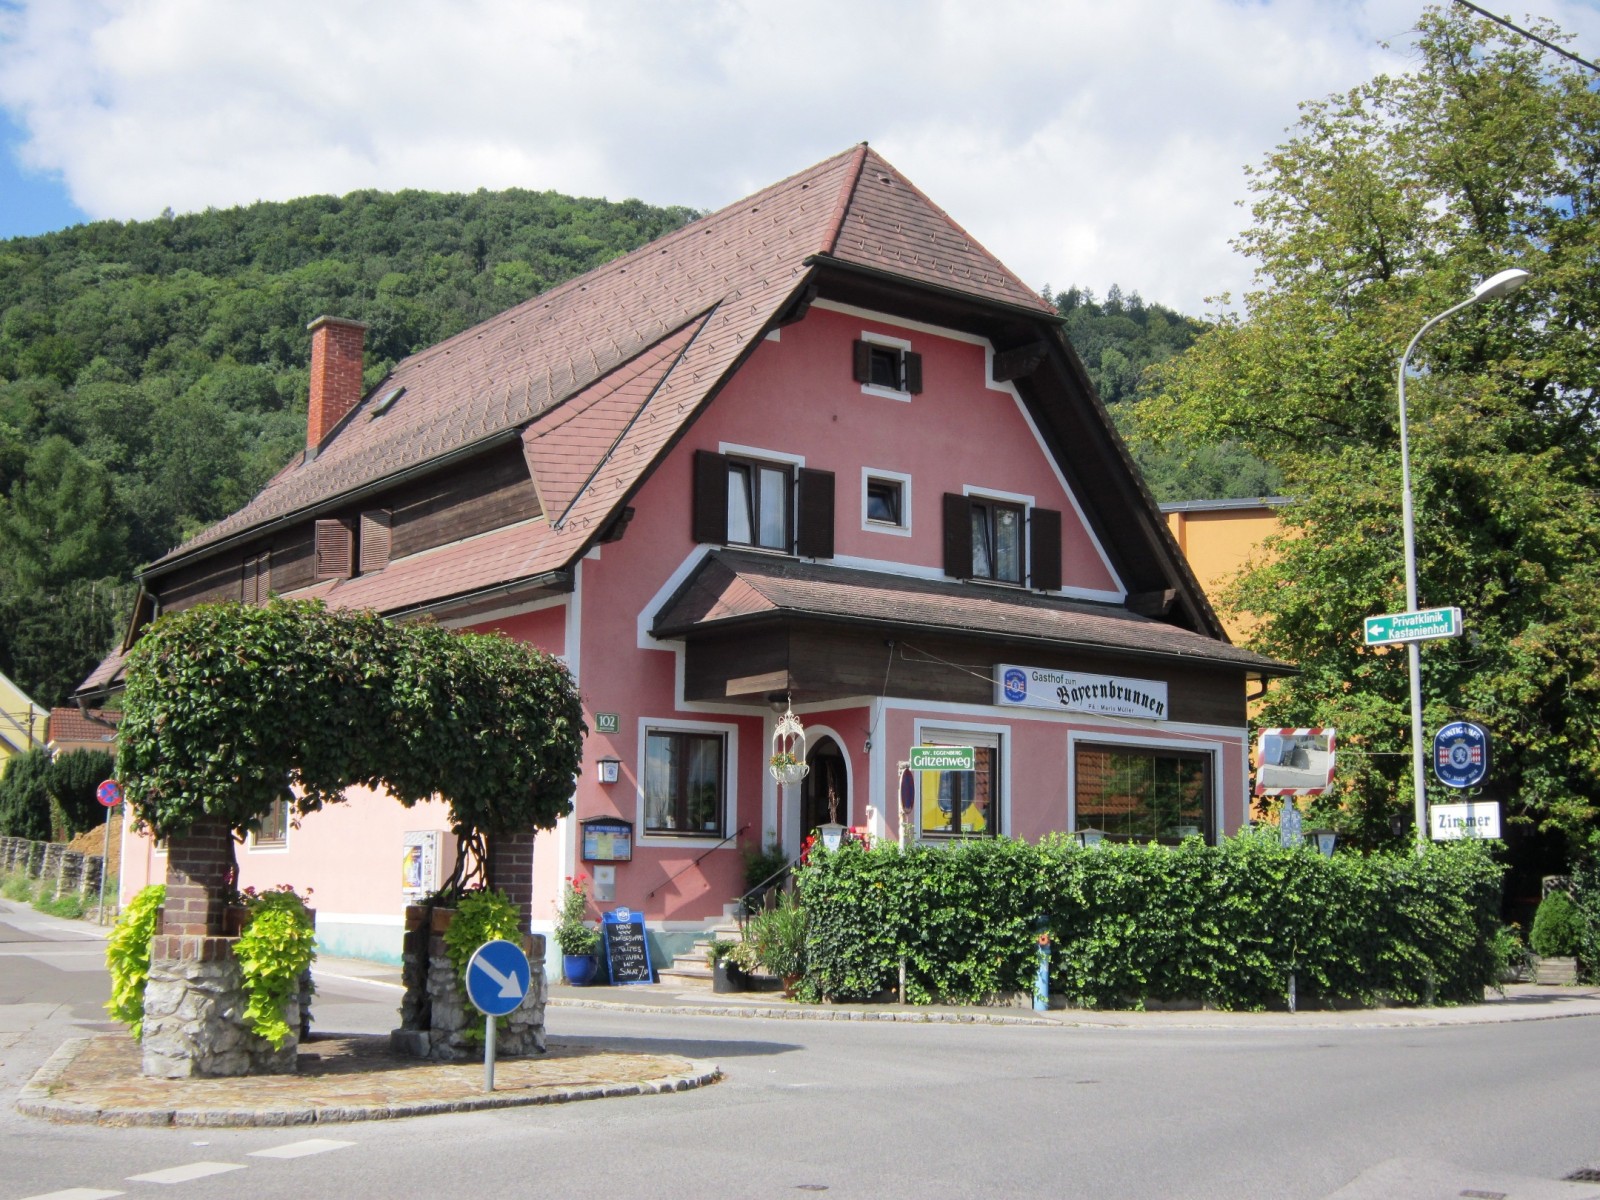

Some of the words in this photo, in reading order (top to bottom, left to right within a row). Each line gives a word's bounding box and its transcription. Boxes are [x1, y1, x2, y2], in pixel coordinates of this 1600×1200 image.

[1392, 611, 1444, 627] Privatklinik
[1388, 622, 1449, 639] Kastanienhof
[1031, 670, 1064, 684] Gasthof
[1056, 680, 1164, 716] Bayernbrunnen
[599, 715, 615, 727] 102
[913, 755, 971, 769] Gritzenweg
